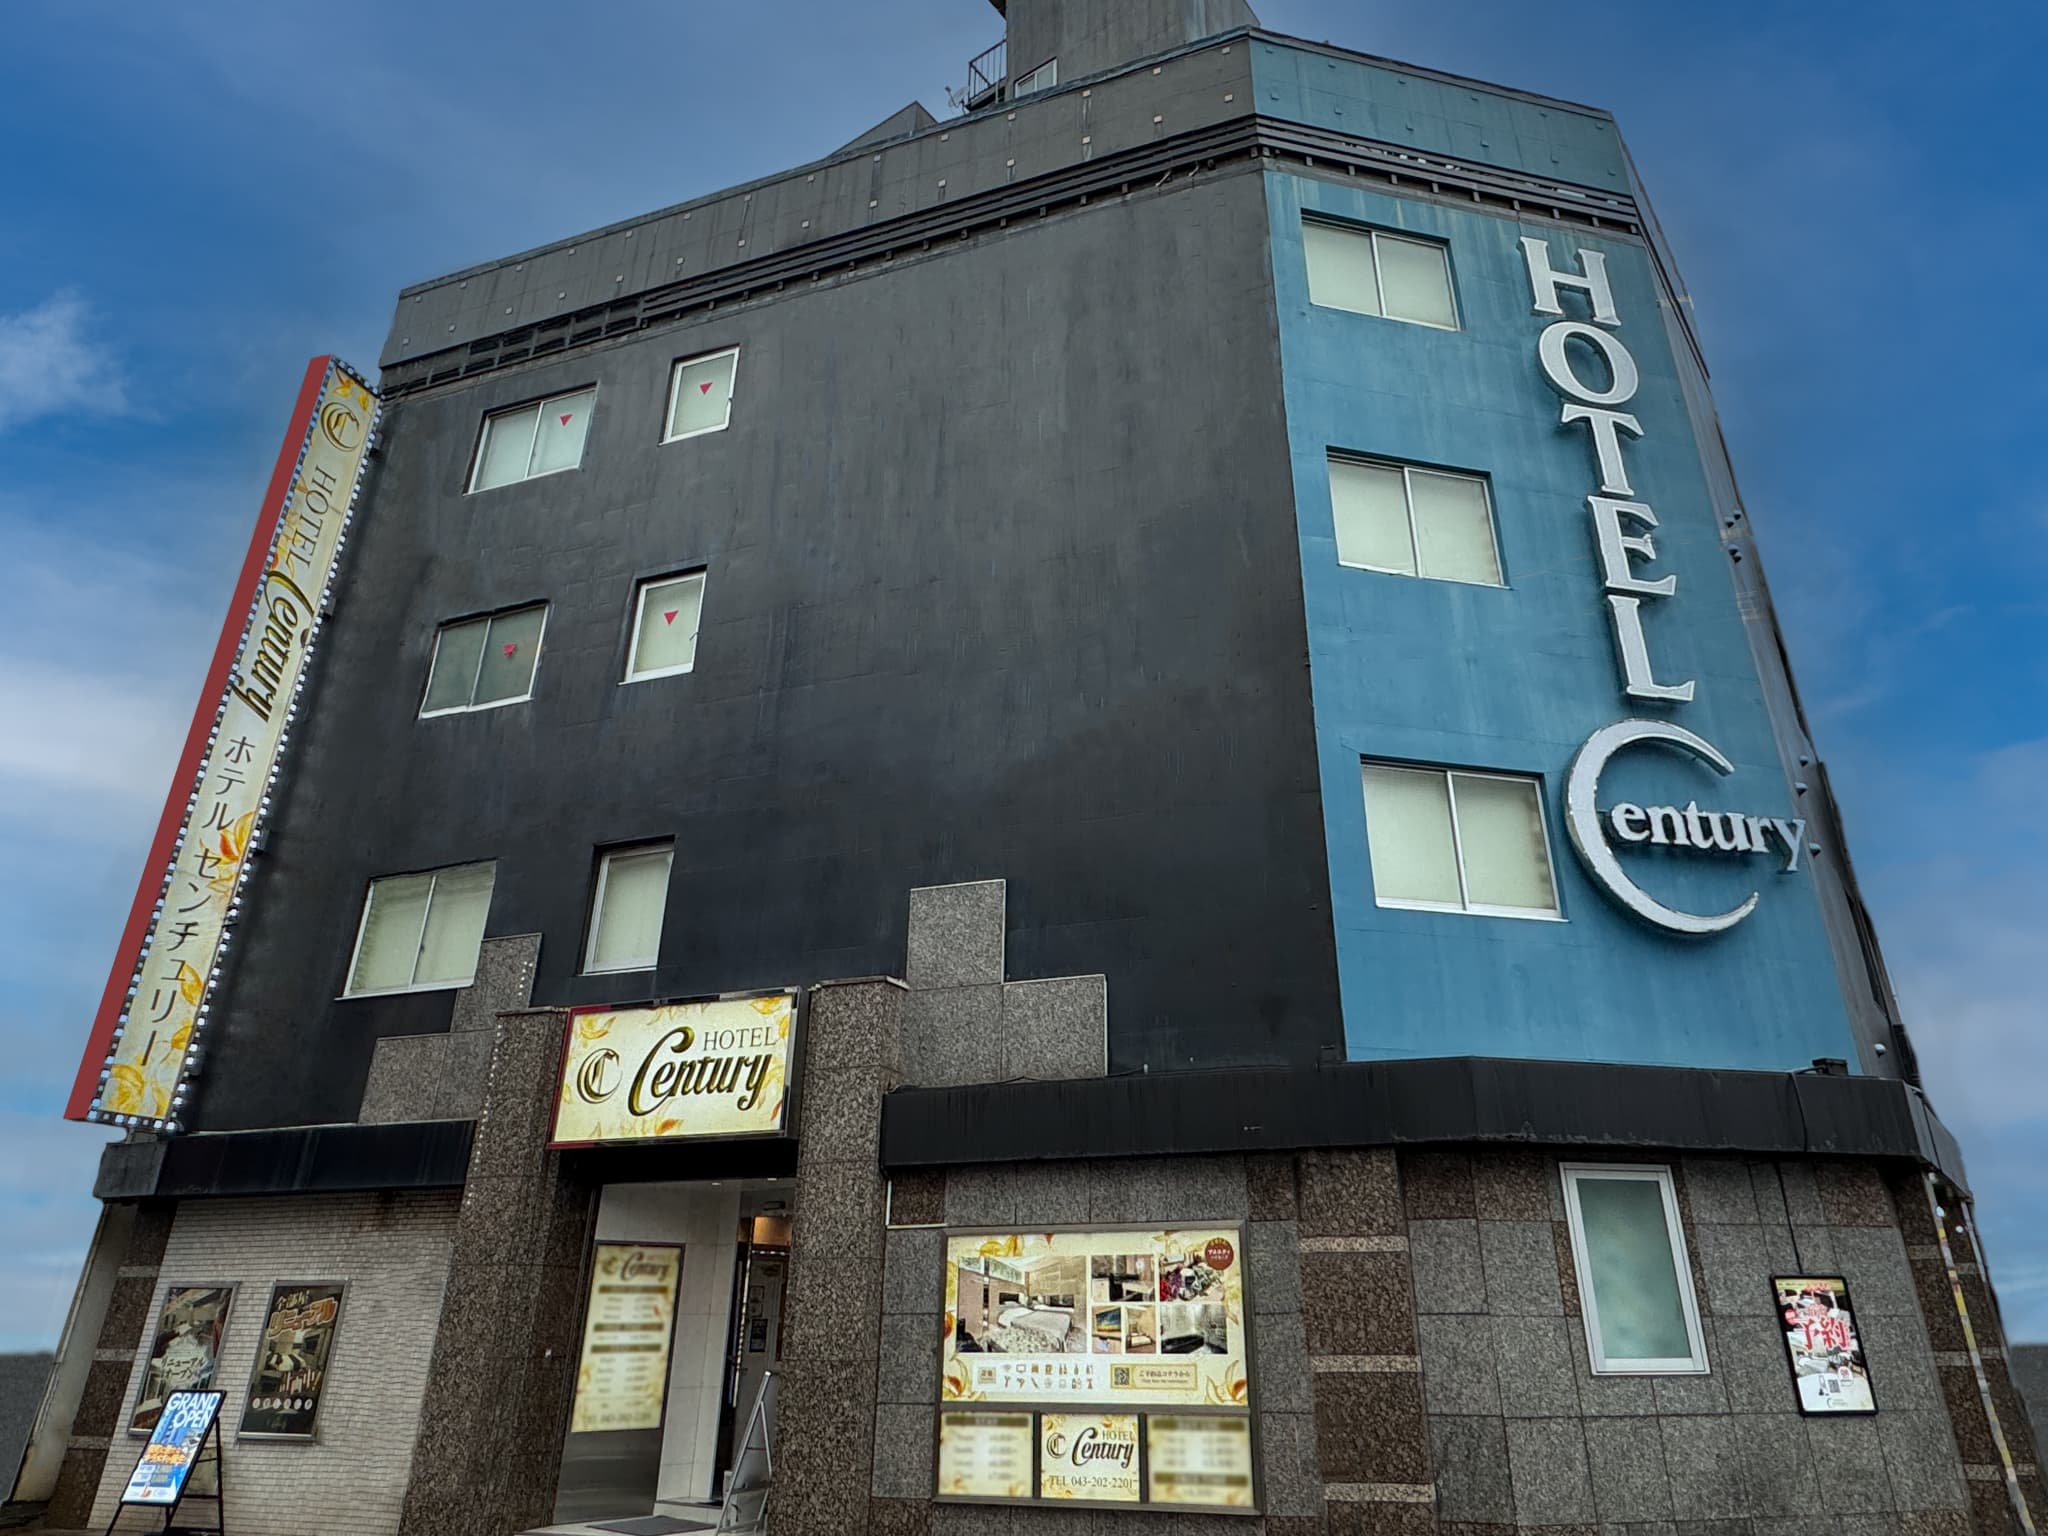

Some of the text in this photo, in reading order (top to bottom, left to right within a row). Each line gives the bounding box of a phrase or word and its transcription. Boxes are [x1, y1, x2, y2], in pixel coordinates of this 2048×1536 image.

[1520, 236, 1696, 703] HOTEL
[285, 465, 337, 568] HOTEL
[231, 570, 316, 724] Century
[1566, 718, 1806, 936] Century
[142, 735, 256, 1067] ホテル センチュリー
[628, 1026, 773, 1117] Century
[703, 1026, 777, 1051] HOTEL
[166, 1392, 221, 1411] GRAND
[173, 1408, 212, 1429] OPEN
[1102, 1429, 1136, 1441] HOTEL
[1049, 1475, 1066, 1487] TEL
[1071, 1426, 1134, 1469] Century
